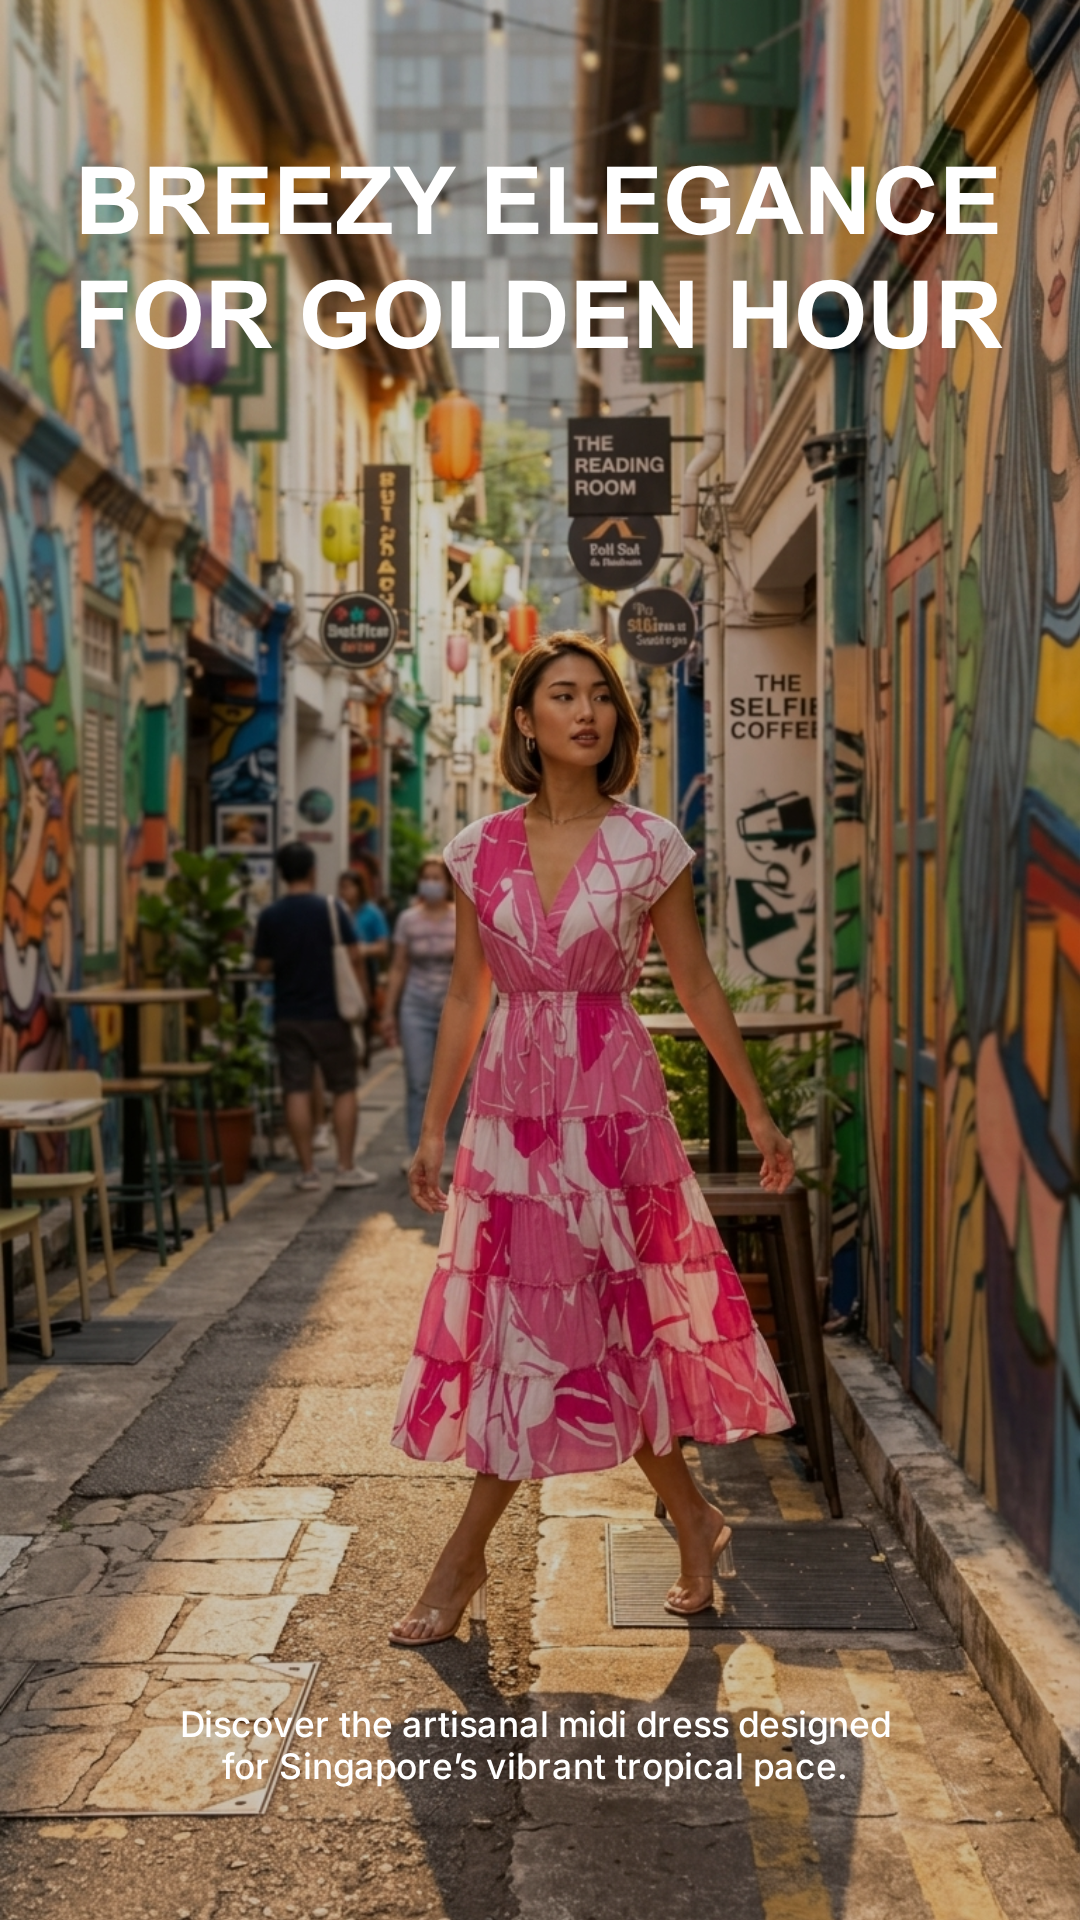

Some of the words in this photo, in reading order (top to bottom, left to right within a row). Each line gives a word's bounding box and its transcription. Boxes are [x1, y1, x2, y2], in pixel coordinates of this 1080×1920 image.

[574, 435, 613, 451] THE
[574, 456, 664, 473] READING
[574, 479, 636, 496] ROOM
[754, 674, 801, 692] THE
